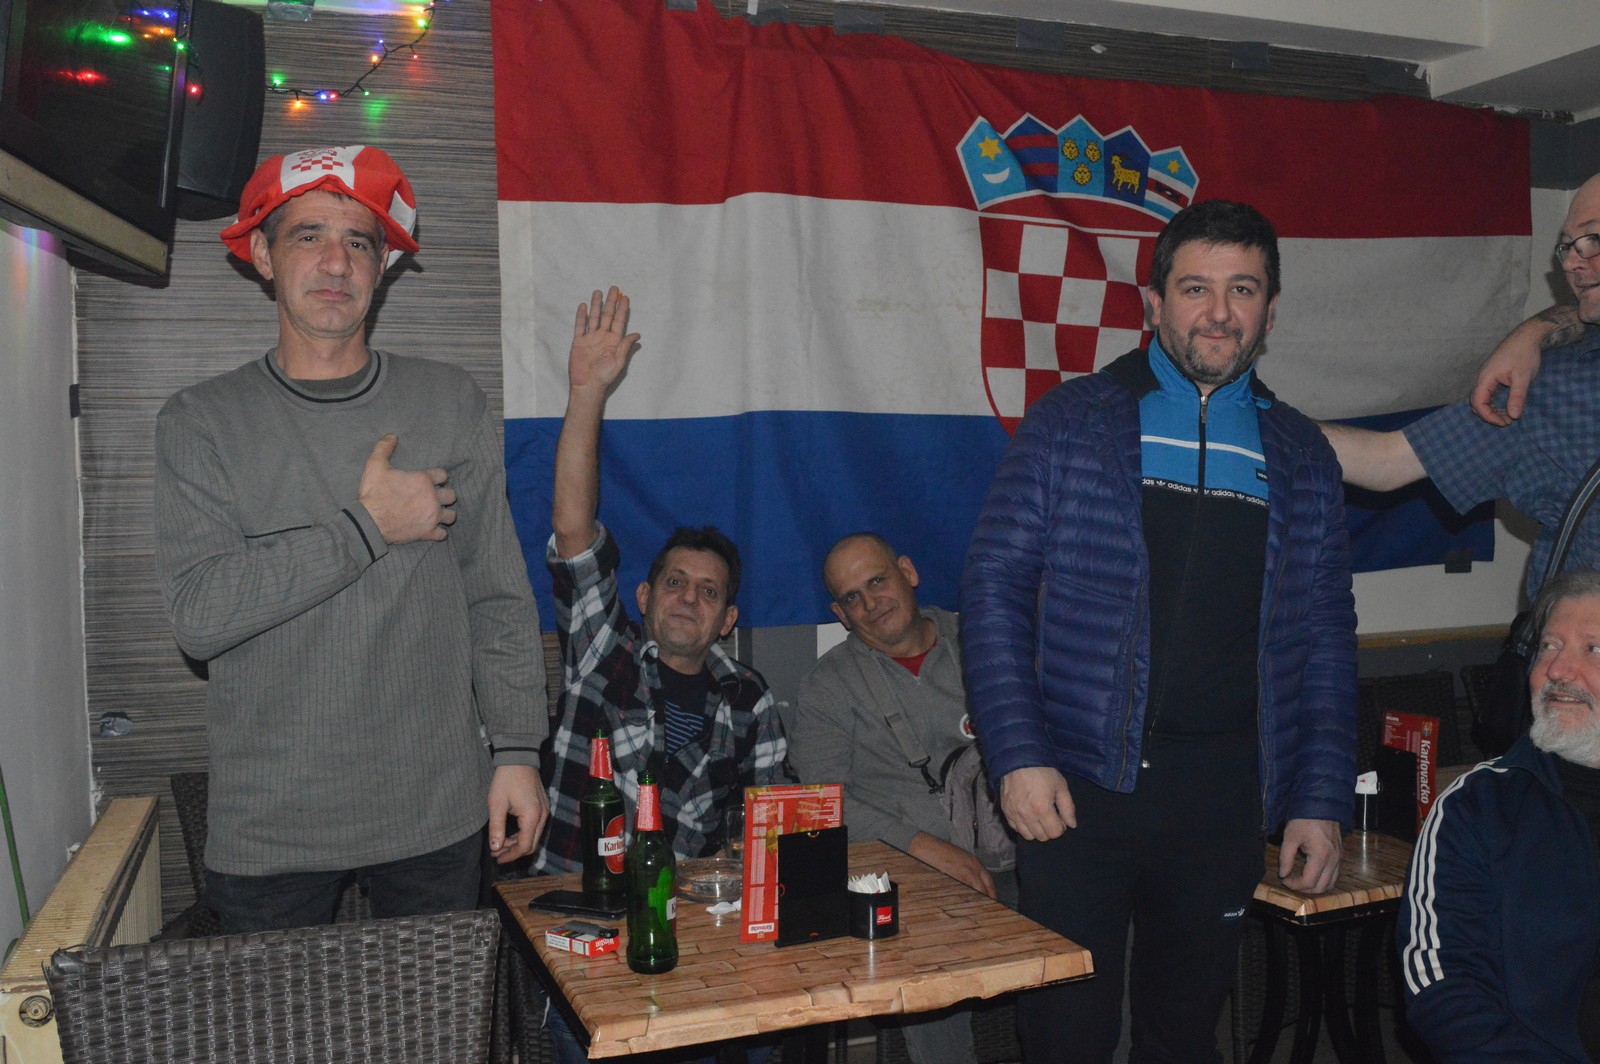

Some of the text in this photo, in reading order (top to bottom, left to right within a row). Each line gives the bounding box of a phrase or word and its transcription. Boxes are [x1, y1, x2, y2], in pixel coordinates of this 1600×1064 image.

[1168, 482, 1192, 492] adidas
[1211, 489, 1235, 498] adidas
[1246, 496, 1266, 507] adidas
[1420, 739, 1431, 804] Karlovačko
